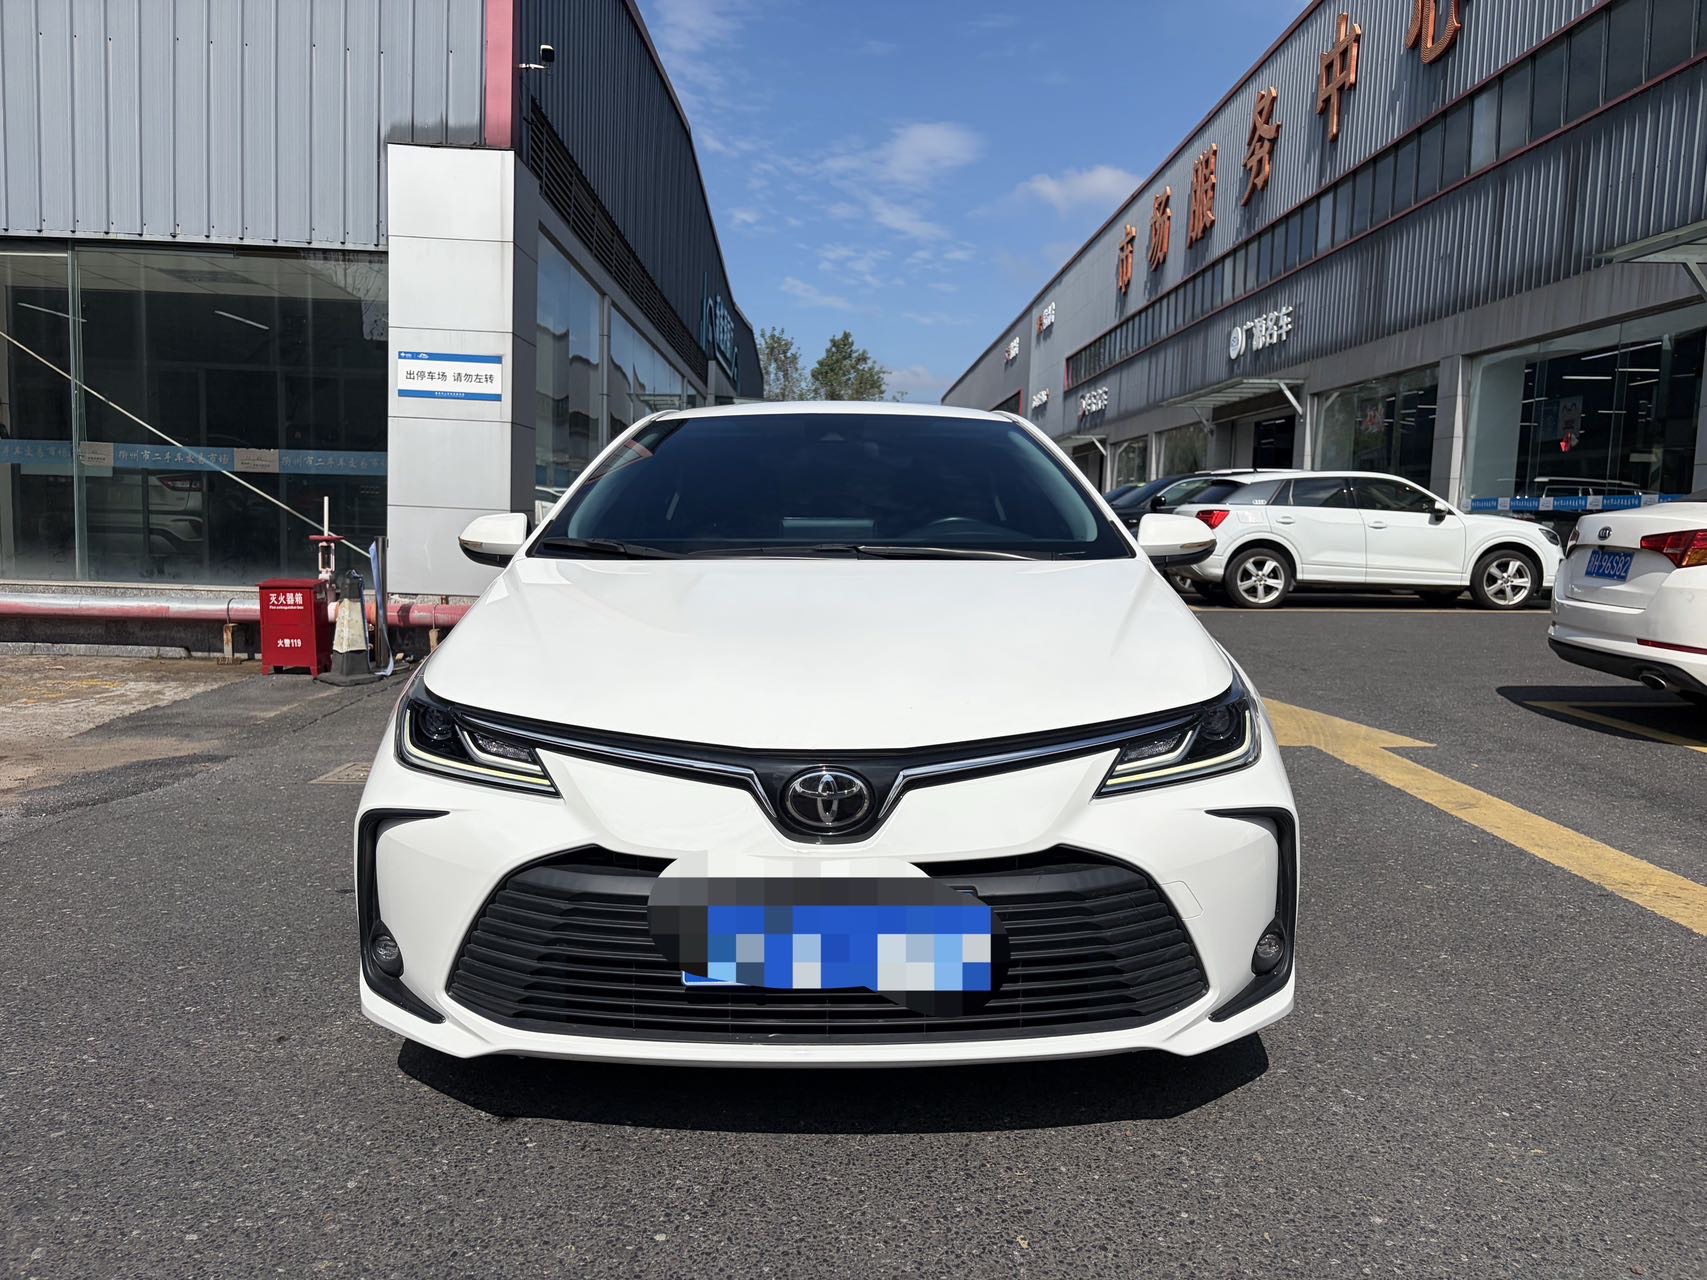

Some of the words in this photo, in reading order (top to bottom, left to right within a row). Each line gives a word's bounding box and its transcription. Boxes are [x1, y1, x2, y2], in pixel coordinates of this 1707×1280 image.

[405, 370, 447, 382] 出停车场
[452, 372, 495, 384] 请勿左转
[269, 592, 303, 605] 灭火器箱
[277, 638, 302, 648] 火警119
